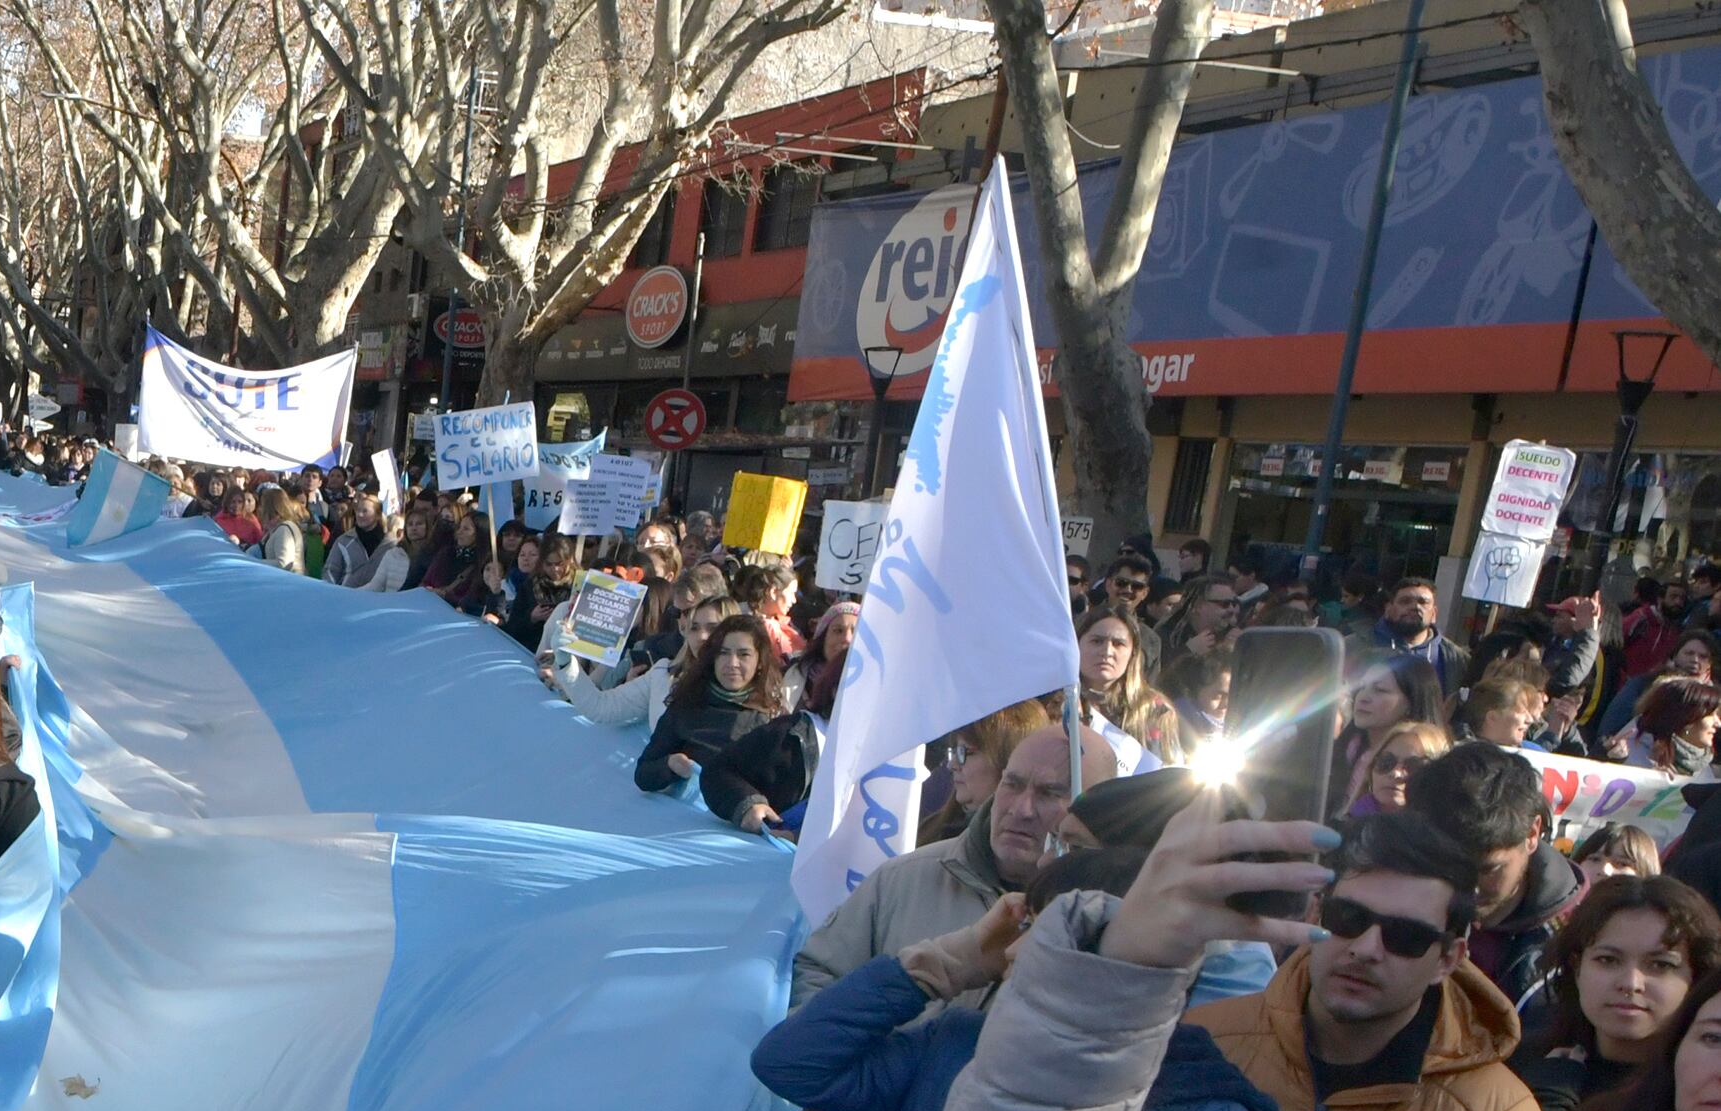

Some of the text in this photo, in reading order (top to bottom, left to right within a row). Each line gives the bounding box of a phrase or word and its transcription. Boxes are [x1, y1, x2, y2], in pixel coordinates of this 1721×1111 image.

[632, 290, 681, 319] CRACK'S
[640, 321, 666, 337] SPORT
[183, 359, 302, 411] SUTE
[440, 409, 533, 436] RECOMPONER
[470, 436, 496, 448] EL
[440, 442, 535, 481] SALARIO
[1515, 450, 1561, 467] ¡SUELDO
[1507, 465, 1559, 483] DECENTE!
[1497, 492, 1552, 511] DIGNIDAD
[1495, 508, 1545, 526] DOCENTE
[593, 588, 631, 604] DOCENTE
